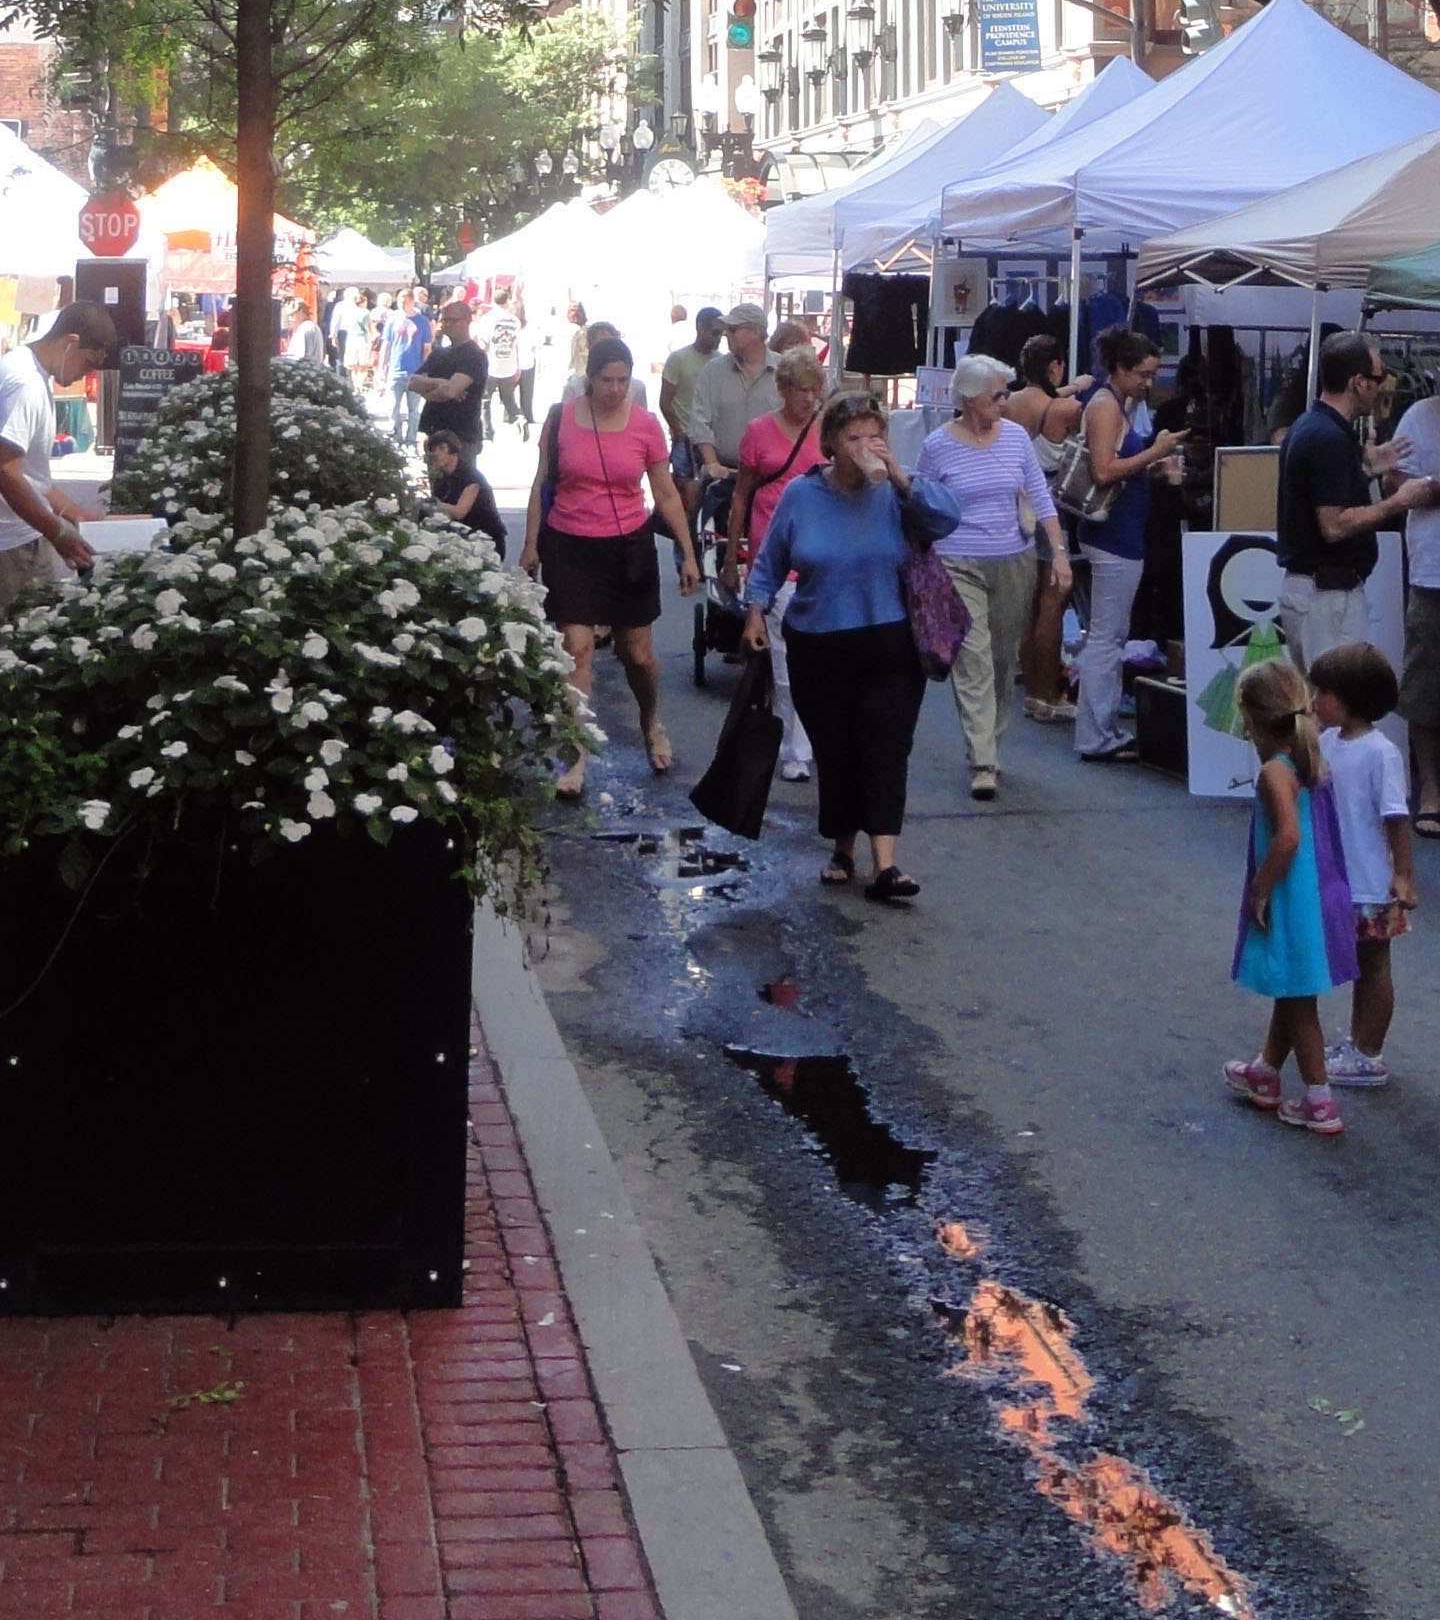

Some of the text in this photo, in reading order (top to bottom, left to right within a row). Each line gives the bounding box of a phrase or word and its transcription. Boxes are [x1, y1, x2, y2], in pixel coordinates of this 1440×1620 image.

[982, 2, 1035, 12] UNIVERSITY
[994, 38, 1028, 47] CAMPUS
[81, 212, 138, 237] STOP
[139, 368, 175, 380] COFFEE
